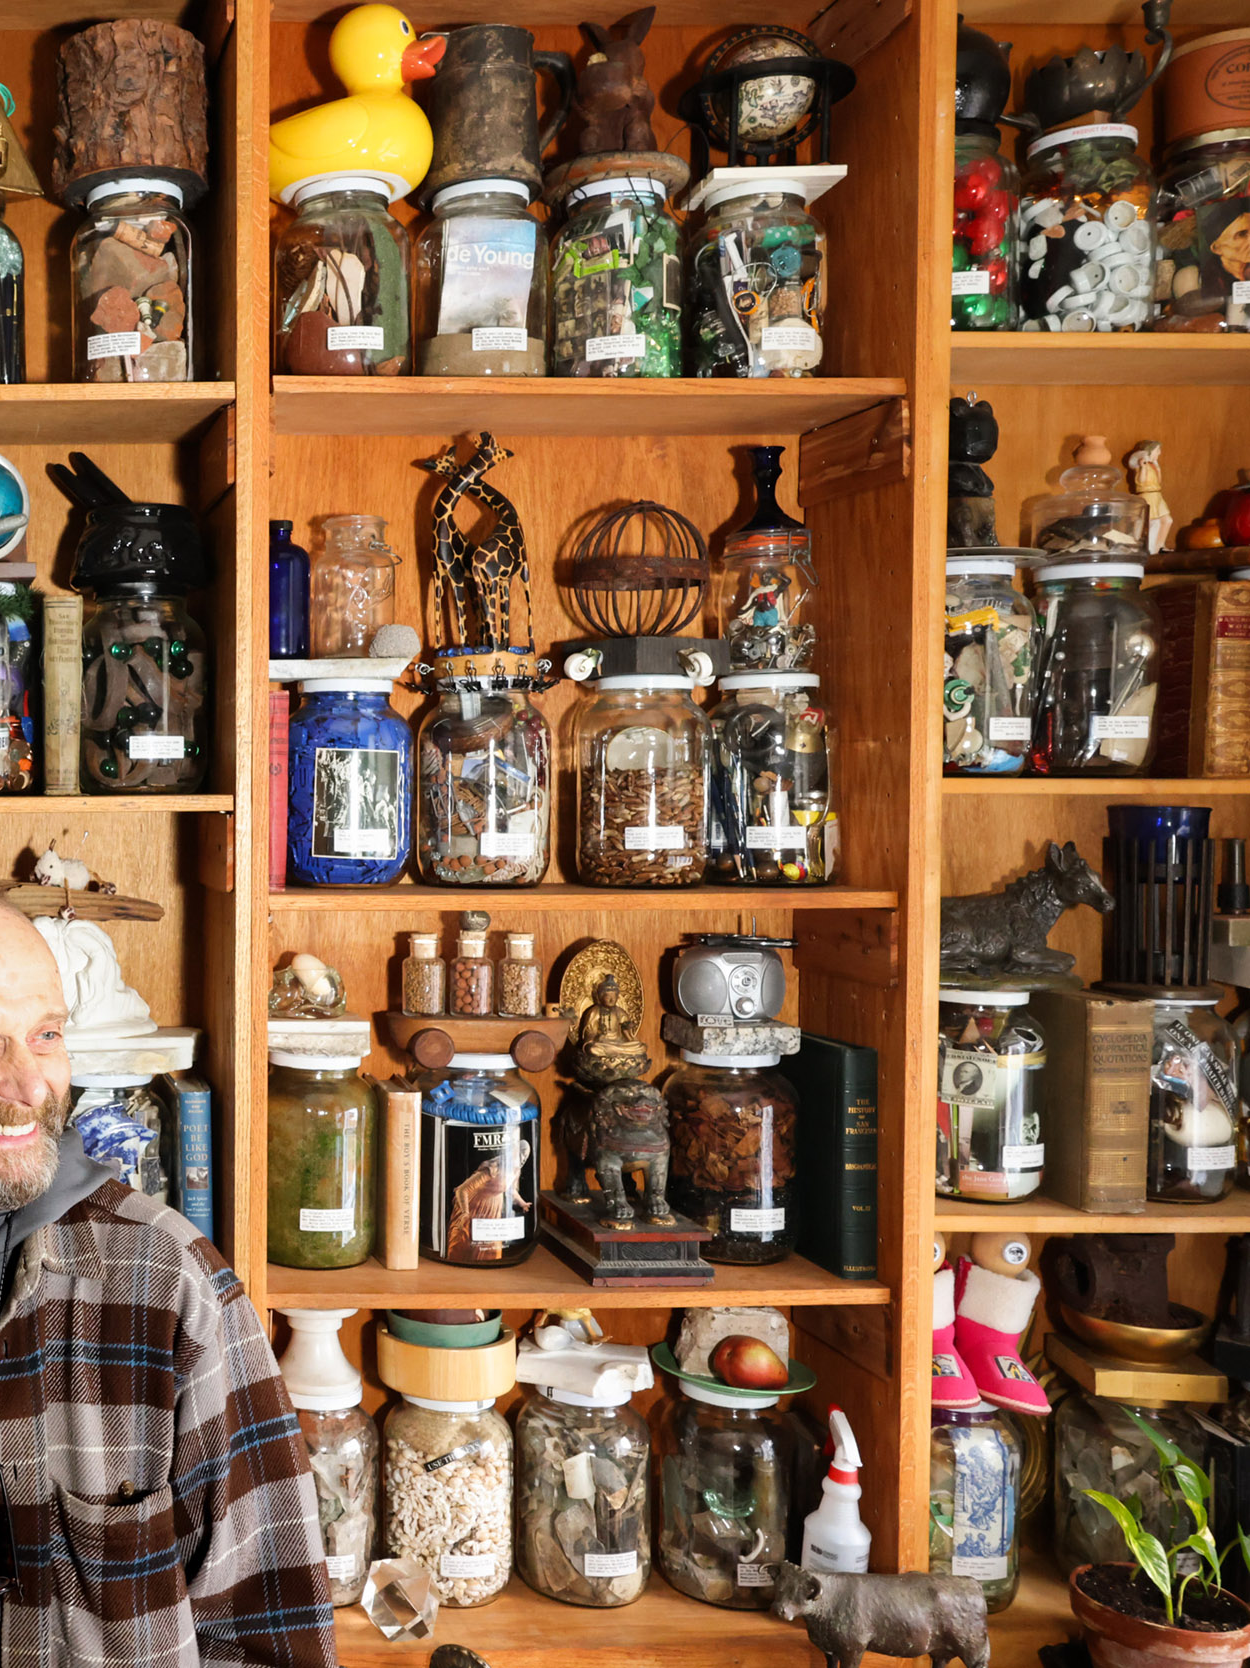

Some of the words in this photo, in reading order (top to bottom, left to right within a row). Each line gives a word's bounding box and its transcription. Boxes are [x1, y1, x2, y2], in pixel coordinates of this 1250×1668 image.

[447, 244, 471, 263] de
[473, 244, 535, 270] Young
[1093, 1034, 1148, 1044] CYCLOPEDIA
[1093, 1054, 1148, 1066] QUOTATIONS
[183, 1124, 208, 1133] POET
[191, 1134, 202, 1142] BE
[185, 1144, 208, 1152] LIKE
[185, 1153, 208, 1162] GOD
